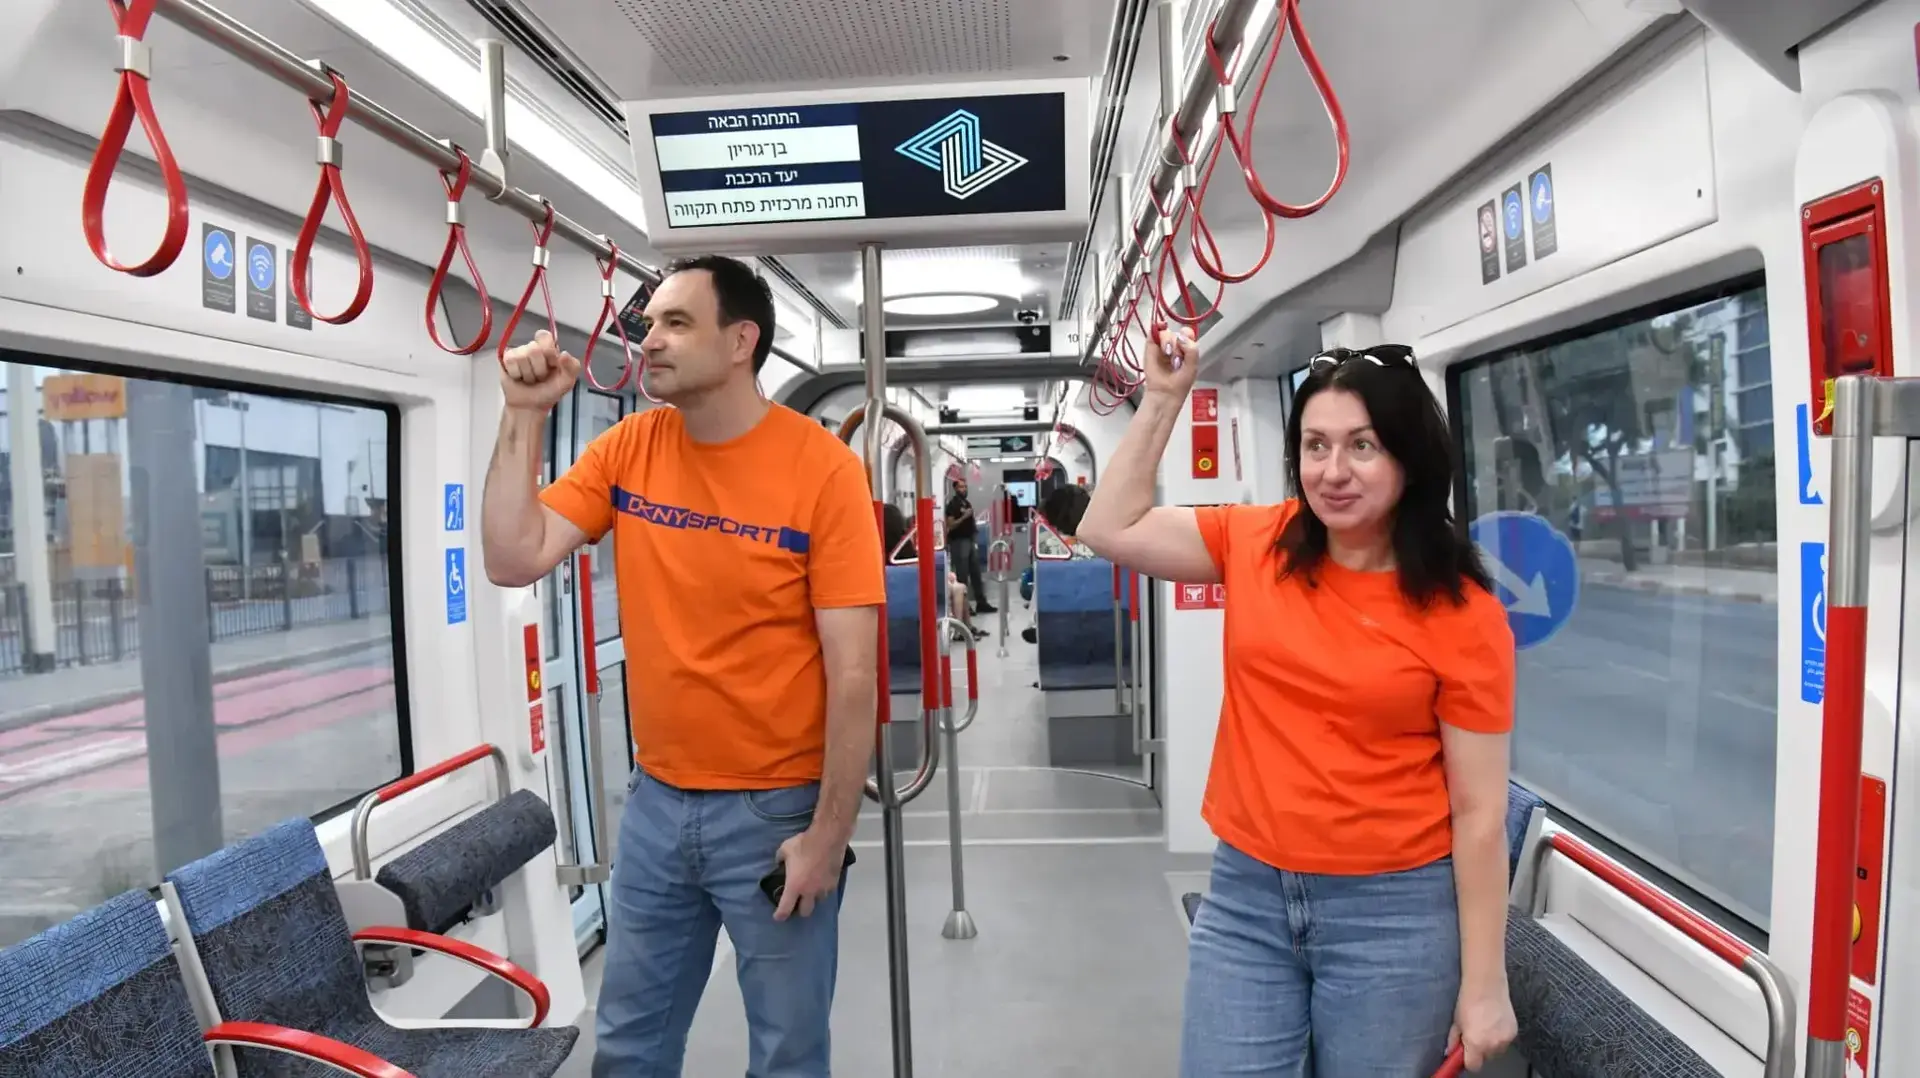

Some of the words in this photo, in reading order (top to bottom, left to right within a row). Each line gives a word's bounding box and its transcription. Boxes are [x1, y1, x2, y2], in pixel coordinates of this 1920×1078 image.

[707, 114, 748, 129] הבאה
[751, 112, 800, 127] התחנה
[724, 171, 772, 186] הרכבת
[774, 169, 798, 183] יעד
[721, 200, 756, 214] פתח
[759, 197, 813, 213] מרכזית
[816, 195, 859, 210] תחנה
[673, 202, 718, 219] תקווה
